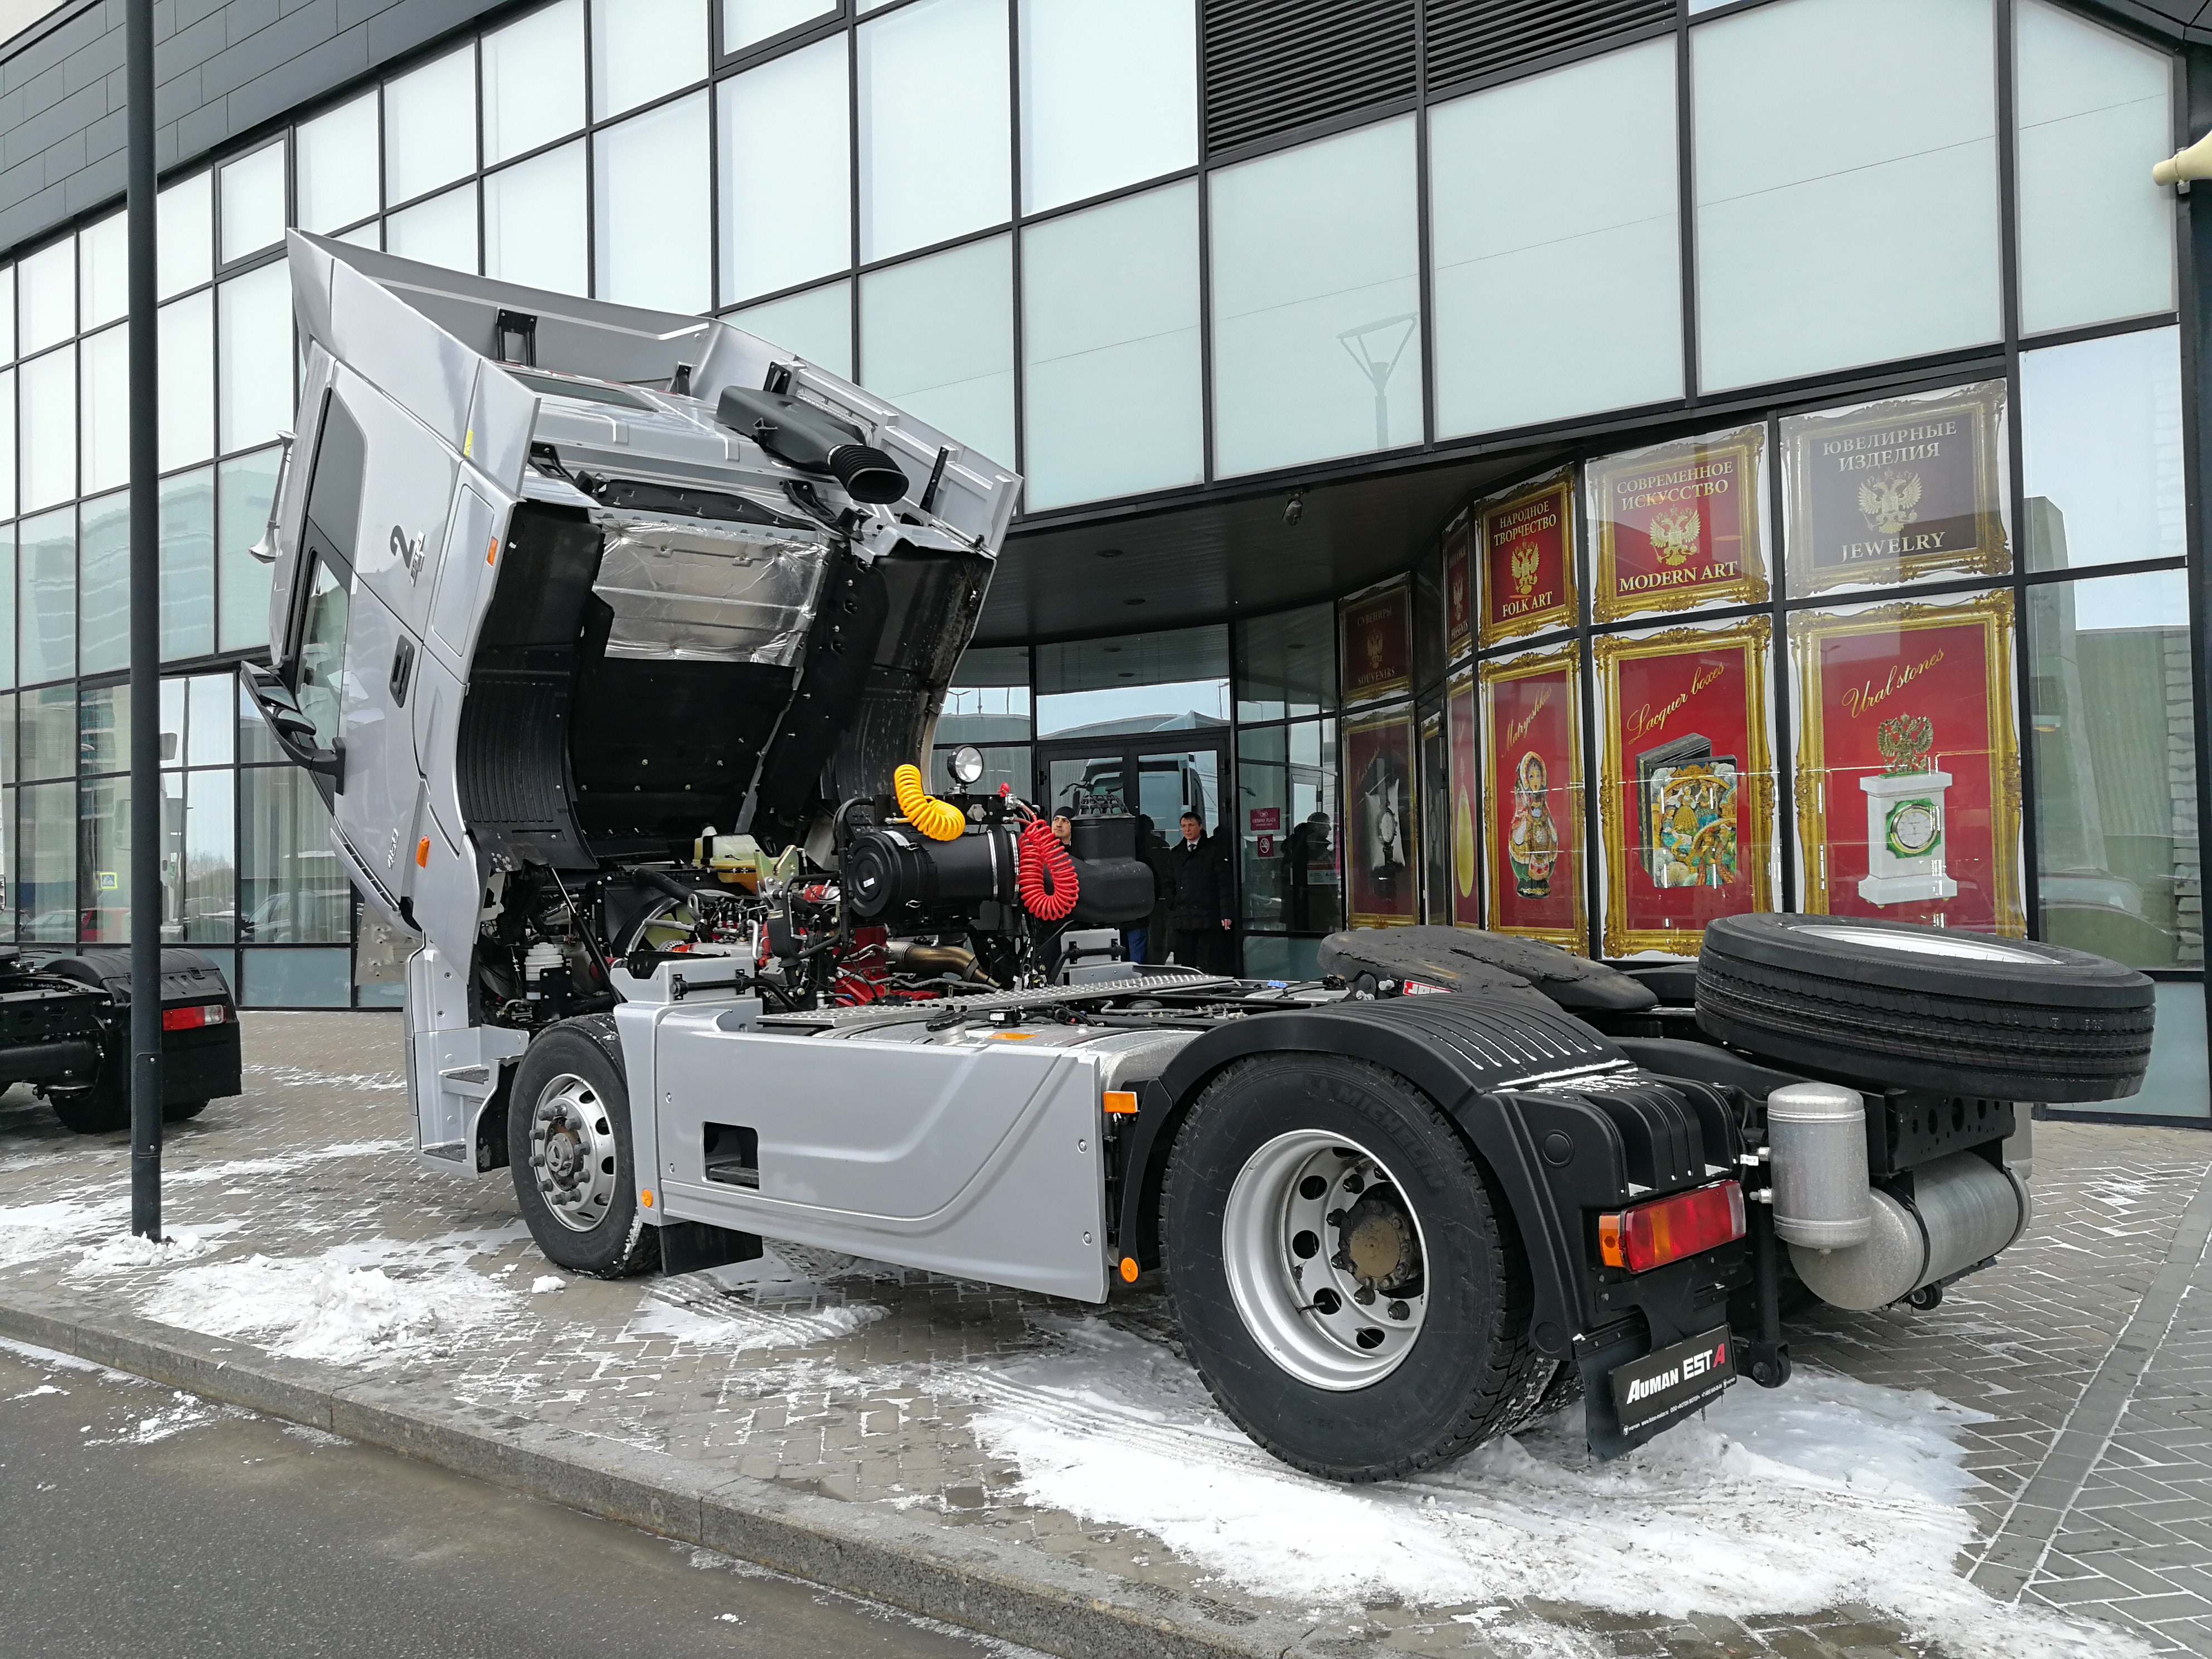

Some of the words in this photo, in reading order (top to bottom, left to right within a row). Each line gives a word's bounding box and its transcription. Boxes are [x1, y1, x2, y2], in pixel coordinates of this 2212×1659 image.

[1823, 420, 1957, 456] ЮВЕЛИРНЫЕ
[1839, 442, 1940, 472] ИЗДЕЛИЯ
[1617, 460, 1733, 494] СОВРЕМЕННОЕ
[1622, 479, 1728, 511] ИСКУССТВО
[1499, 500, 1550, 528] НАРОДНОЕ
[1493, 514, 1557, 547] ТВОРЧЕСТВО
[390, 525, 415, 569] 2
[1841, 532, 1946, 562] JEWELRY
[1619, 567, 1698, 593] MODERN
[1700, 561, 1738, 580] ART
[1357, 606, 1392, 627] СУВЕНИРЫ
[1502, 599, 1529, 618] FOLK
[1531, 591, 1554, 610] ART
[1357, 667, 1395, 685] SOUVENIRS
[1842, 663, 1899, 719] Ural
[1896, 648, 1945, 687] stones
[1627, 693, 1688, 745] Lacquer
[1691, 662, 1725, 695] boxes
[1337, 1085, 1446, 1188] MICHELIN
[1627, 1367, 1679, 1404] AUMAN
